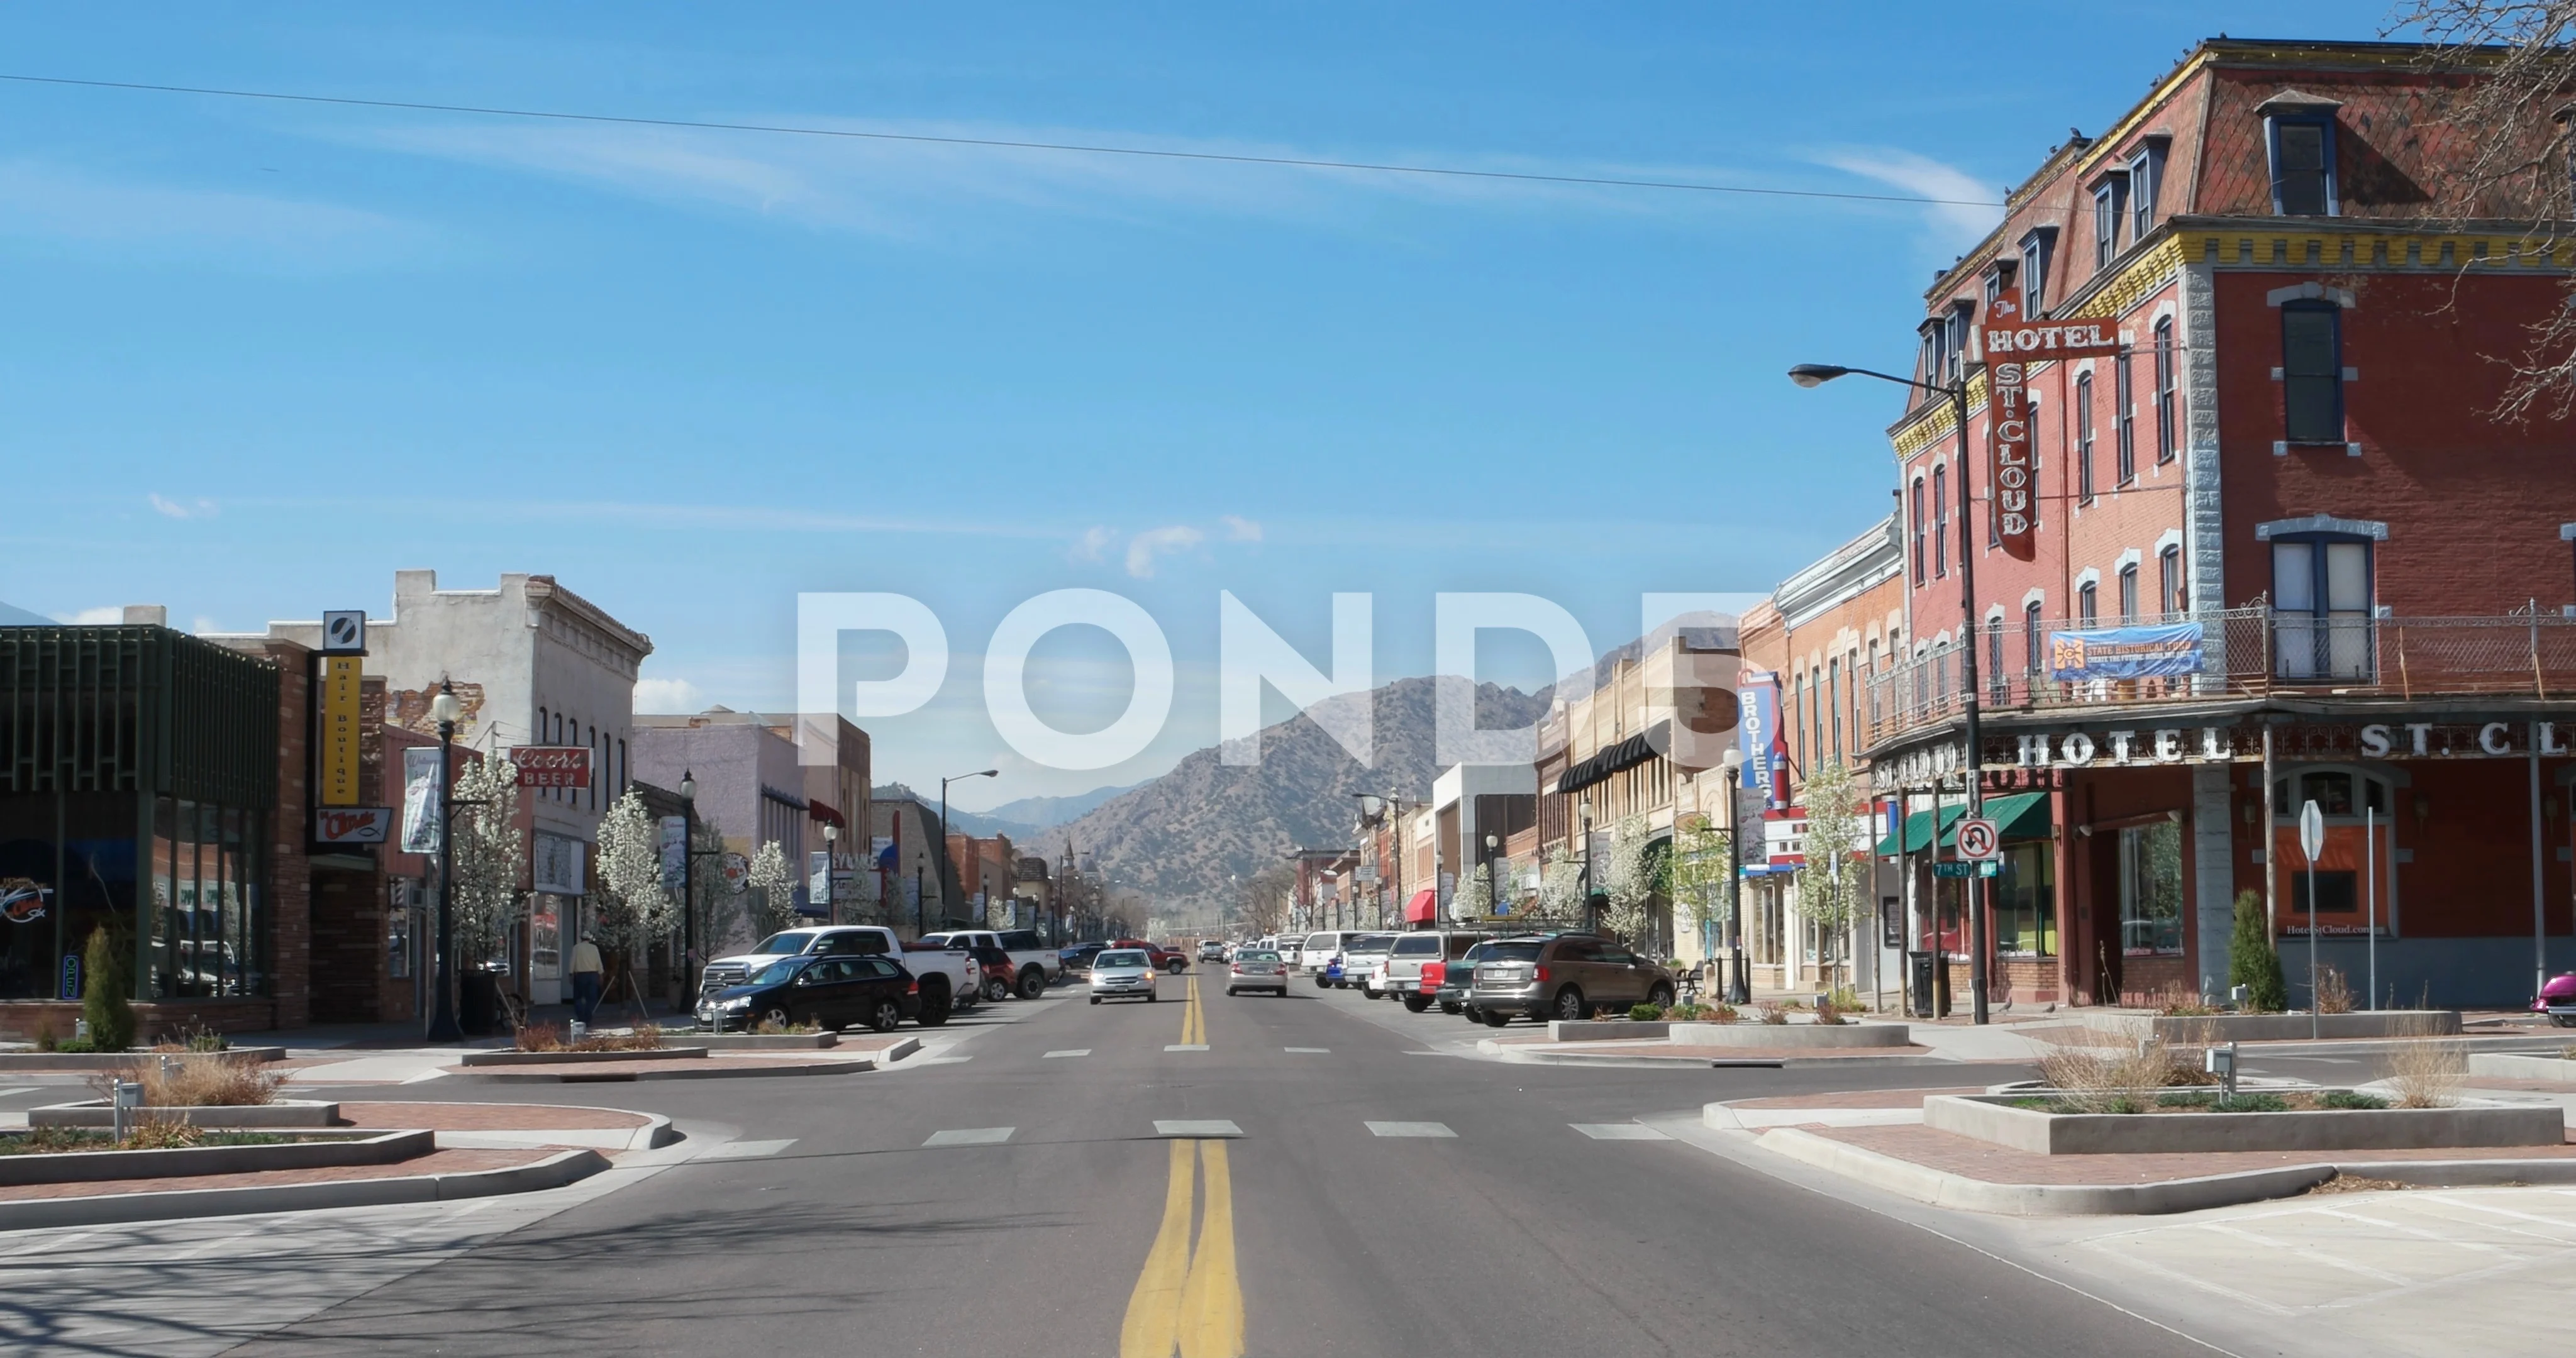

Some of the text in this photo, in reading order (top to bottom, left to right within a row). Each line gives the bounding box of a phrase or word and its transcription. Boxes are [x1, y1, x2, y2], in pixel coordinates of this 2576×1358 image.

[1994, 300, 2016, 318] The
[1987, 324, 2115, 353] HOTEL
[1997, 420, 2028, 536] CLOUD
[2087, 646, 2114, 656] STATE
[2116, 642, 2165, 655] HISTORICAL
[336, 662, 350, 794] Hair Boutique
[2362, 722, 2450, 758] ST.
[513, 748, 581, 770] Coors
[2016, 727, 2232, 768] HOTEL
[524, 772, 575, 786] BEER
[1899, 741, 1957, 788] CLOUD
[1936, 863, 1968, 876] 7TH ST
[2287, 924, 2370, 935] HoteStCloud.com
[65, 958, 76, 996] OPEN
